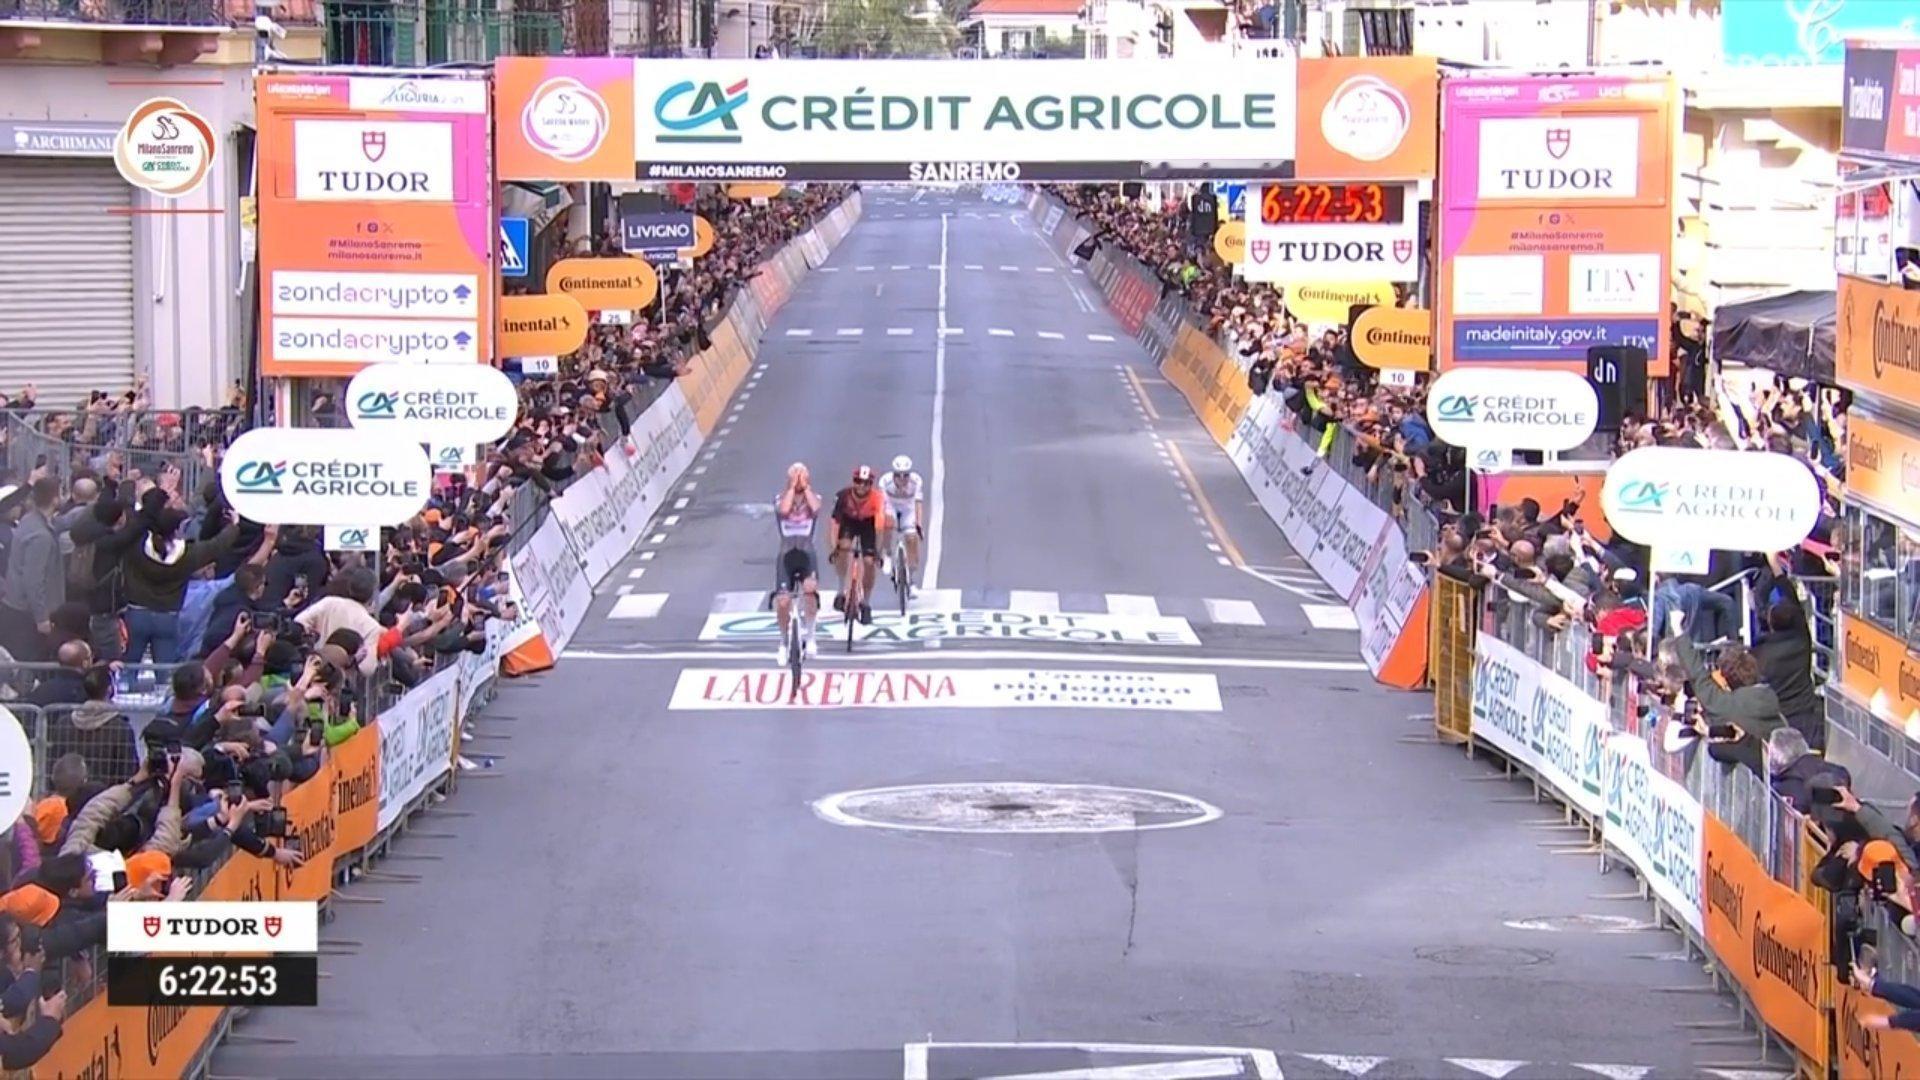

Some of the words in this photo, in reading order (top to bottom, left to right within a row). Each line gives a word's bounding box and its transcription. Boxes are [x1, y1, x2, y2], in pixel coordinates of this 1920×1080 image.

[761, 86, 972, 131] CRÉDIT
[984, 93, 1276, 131] AGRICOLE
[648, 164, 787, 178] #MILANOSANREMO
[908, 161, 1021, 181] SANREMO
[1501, 168, 1613, 189] TUDOR
[318, 171, 430, 193] TUDOR
[1262, 182, 1384, 223] 6:22:53
[628, 223, 690, 239] LIVIGNO
[1510, 231, 1604, 241] #MilanoSanremo
[328, 239, 422, 249] #MilanoSanremo
[1278, 241, 1385, 262] TUDOR
[328, 250, 422, 261] milanosanremo.it
[643, 252, 676, 260] LIVIGNO
[559, 276, 632, 291] Continental
[278, 282, 449, 309] zondacrypto
[1298, 286, 1372, 304] Continental
[500, 317, 558, 333] inental
[607, 313, 621, 323] 25
[278, 328, 449, 355] zondacrypto
[1466, 324, 1607, 344] madeinitaly.gov.it
[536, 359, 550, 370] 10
[1390, 373, 1405, 383] 10
[403, 389, 479, 406] CRÉDIT
[1483, 394, 1558, 410] CRÉDIT
[403, 406, 508, 420] AGRICOLE
[1483, 411, 1586, 426] AGRICOLE
[292, 459, 384, 478] CRÉDIT
[292, 480, 418, 497] AGRICOLE
[861, 624, 1184, 643] AGRICOLE
[703, 671, 956, 706] LAURETANA
[1489, 657, 1521, 702] CRÉDIT
[1487, 696, 1527, 745] AGRICOLE
[1753, 909, 1812, 1004] Continental
